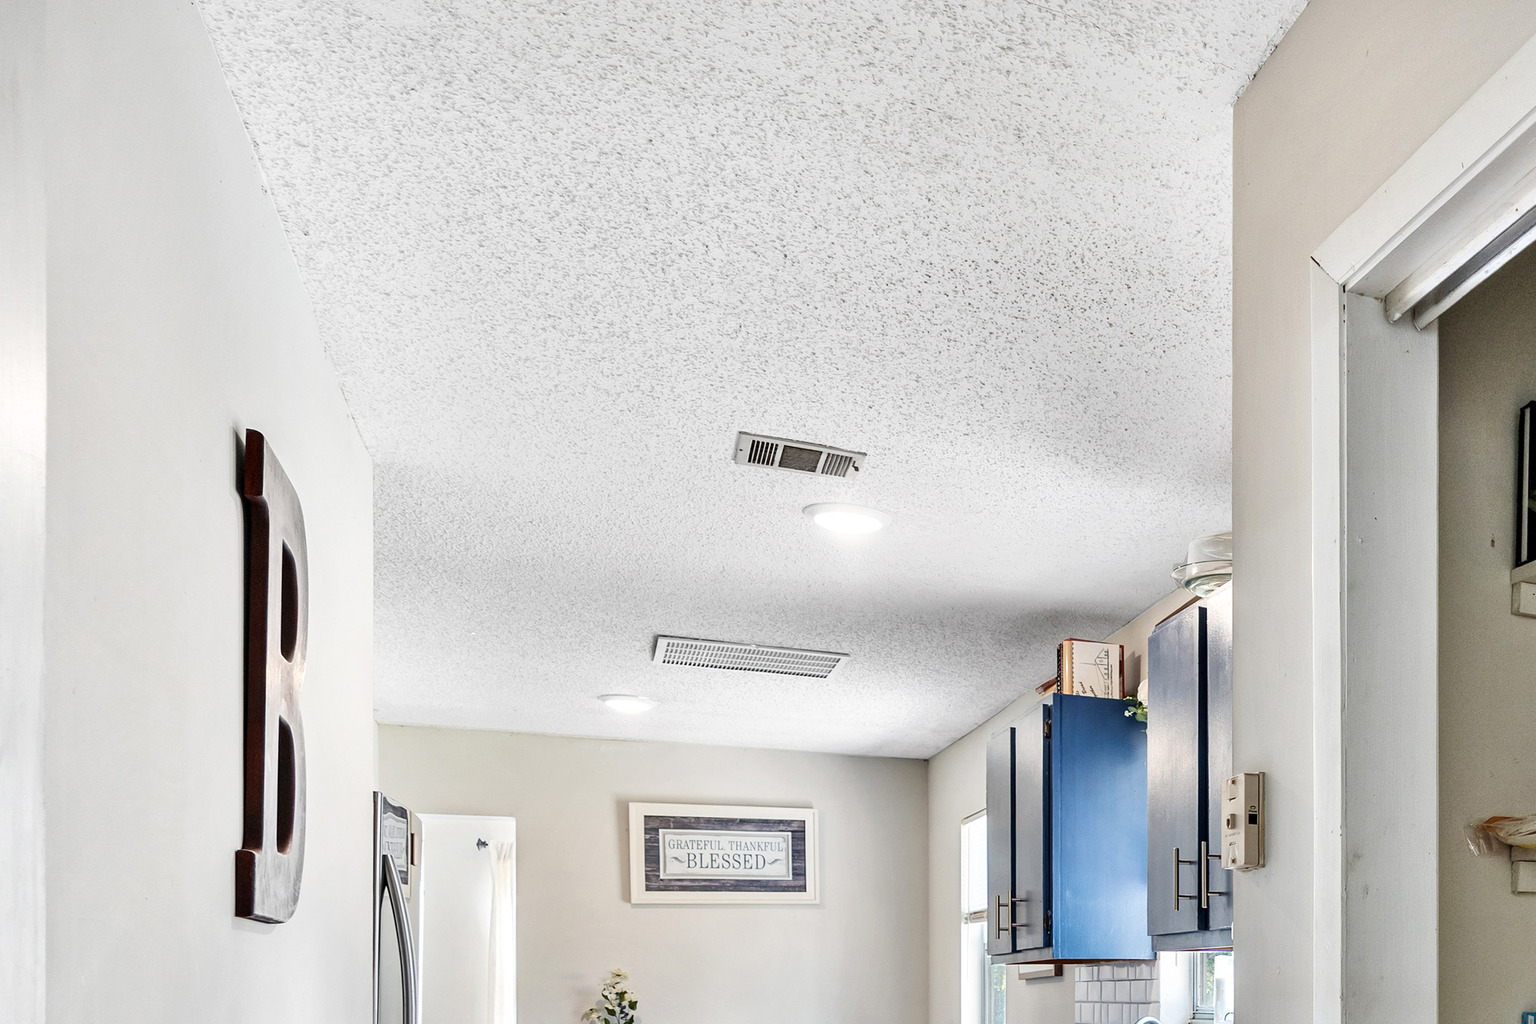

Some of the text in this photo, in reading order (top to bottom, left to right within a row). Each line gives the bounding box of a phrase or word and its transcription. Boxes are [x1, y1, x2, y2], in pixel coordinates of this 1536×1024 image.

[236, 428, 309, 924] B
[728, 841, 784, 851] THANKFUL
[687, 853, 766, 869] BLESSED
